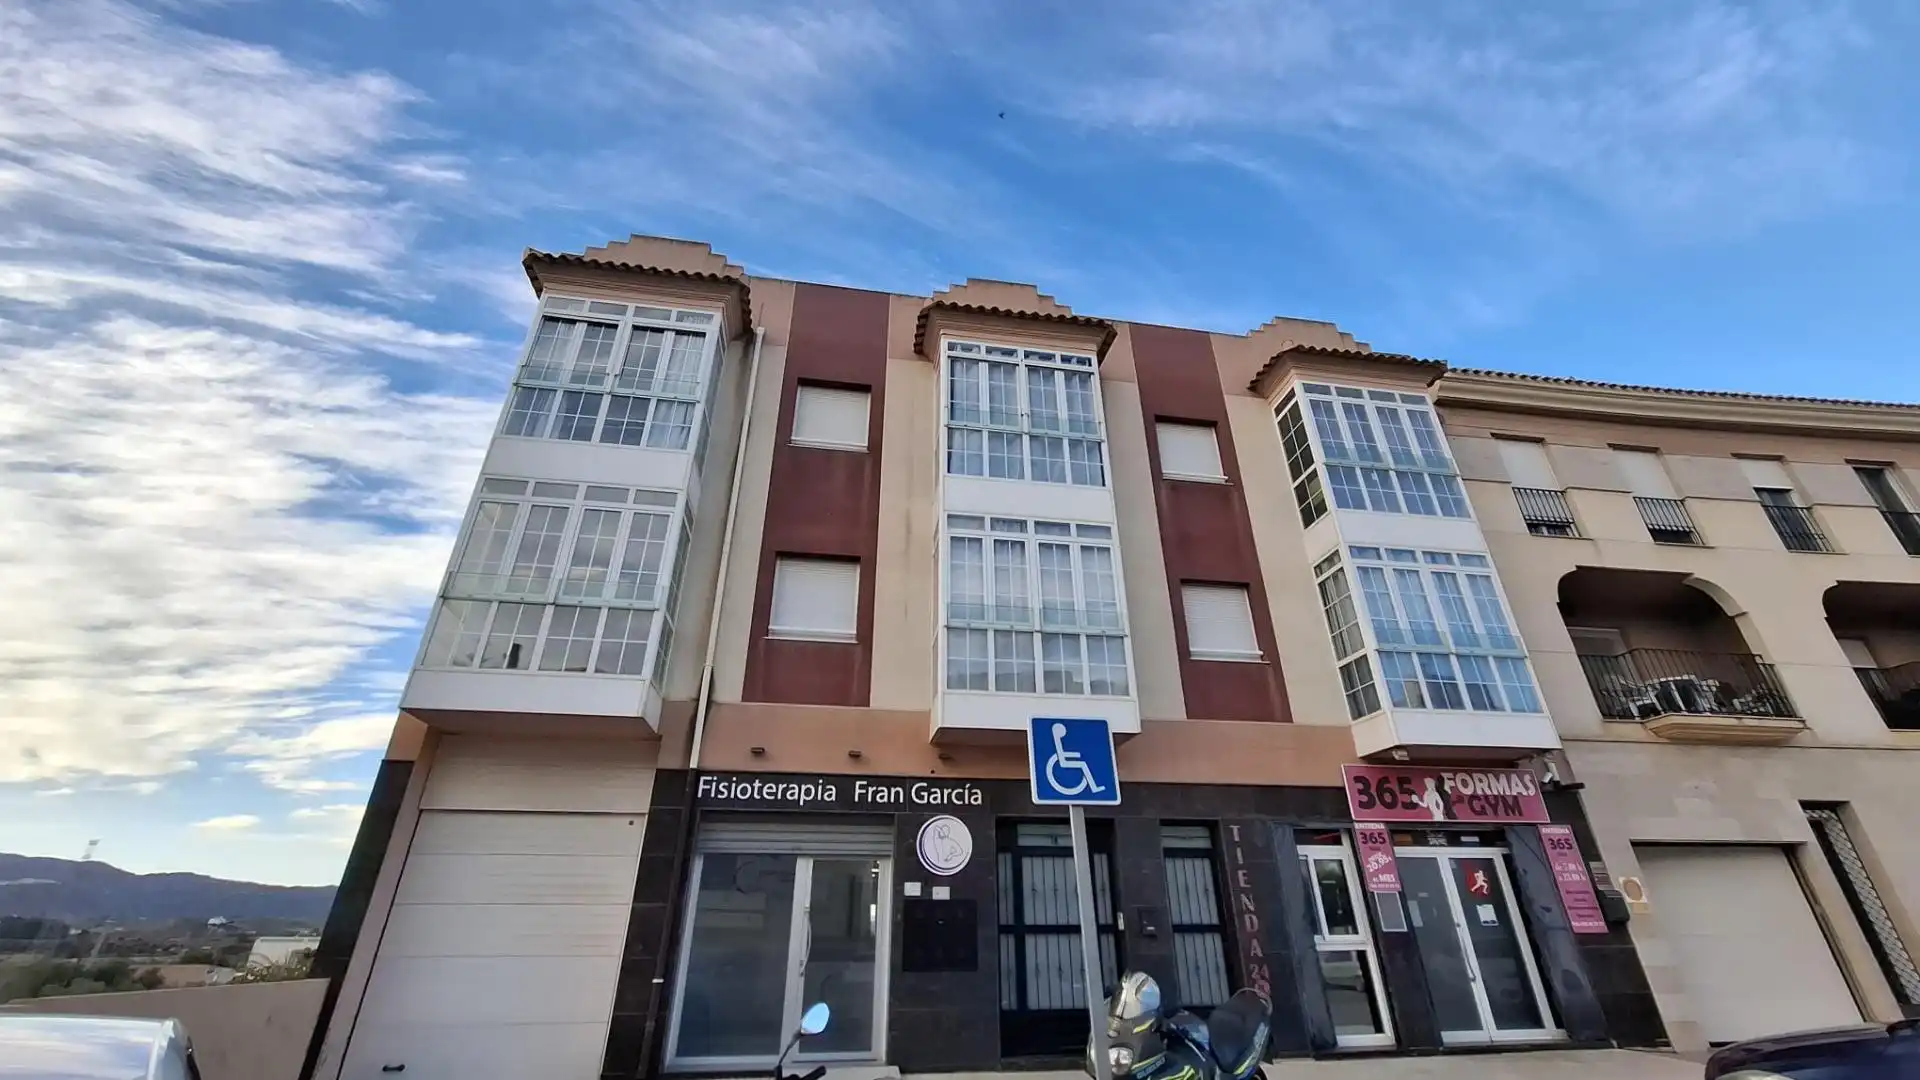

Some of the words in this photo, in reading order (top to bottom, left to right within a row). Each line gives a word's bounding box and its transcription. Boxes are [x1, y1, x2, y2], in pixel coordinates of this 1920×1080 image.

[697, 776, 836, 805] Fisioterapia
[854, 780, 904, 803] Fran
[911, 782, 982, 806] García
[1353, 775, 1418, 810] 365
[1441, 772, 1536, 796] FORMAS
[1467, 794, 1523, 817] GYM
[1360, 832, 1386, 845] 365
[1548, 838, 1573, 850] 365
[1230, 825, 1264, 957] TIENDA
